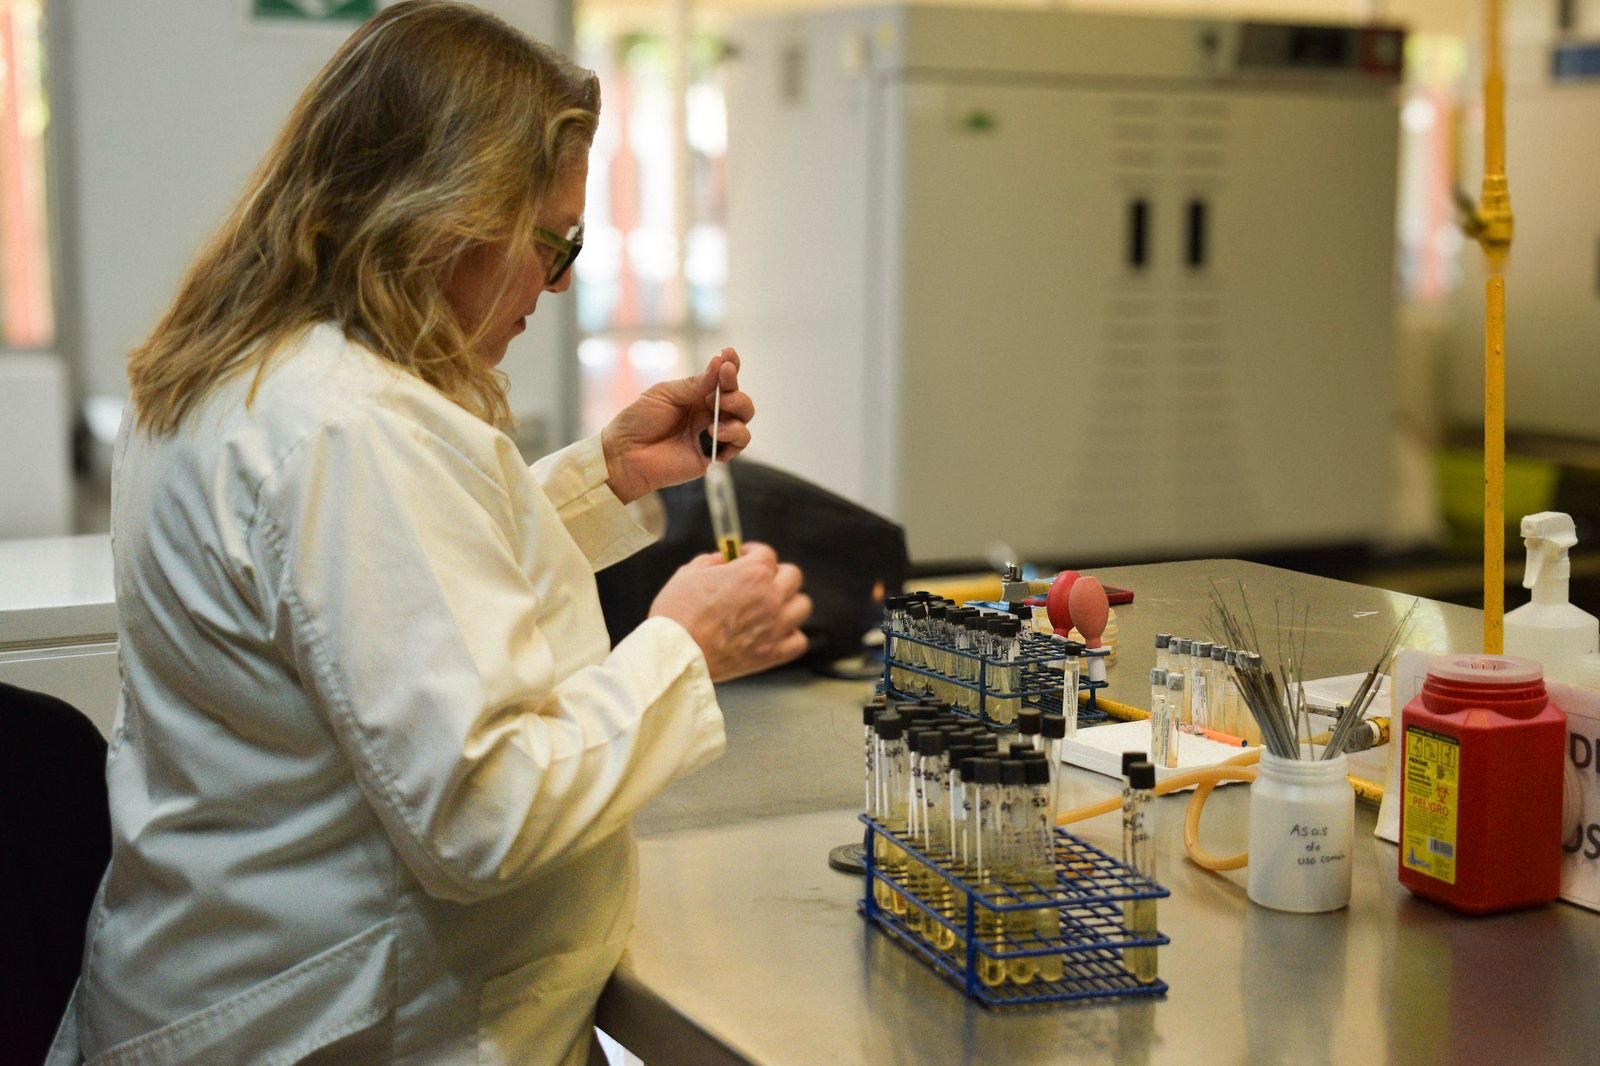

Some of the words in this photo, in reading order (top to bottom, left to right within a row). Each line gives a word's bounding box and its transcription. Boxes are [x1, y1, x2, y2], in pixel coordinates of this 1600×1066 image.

[1569, 732, 1600, 774] D
[1412, 795, 1449, 817] PELIGRO
[1305, 841, 1321, 852] de
